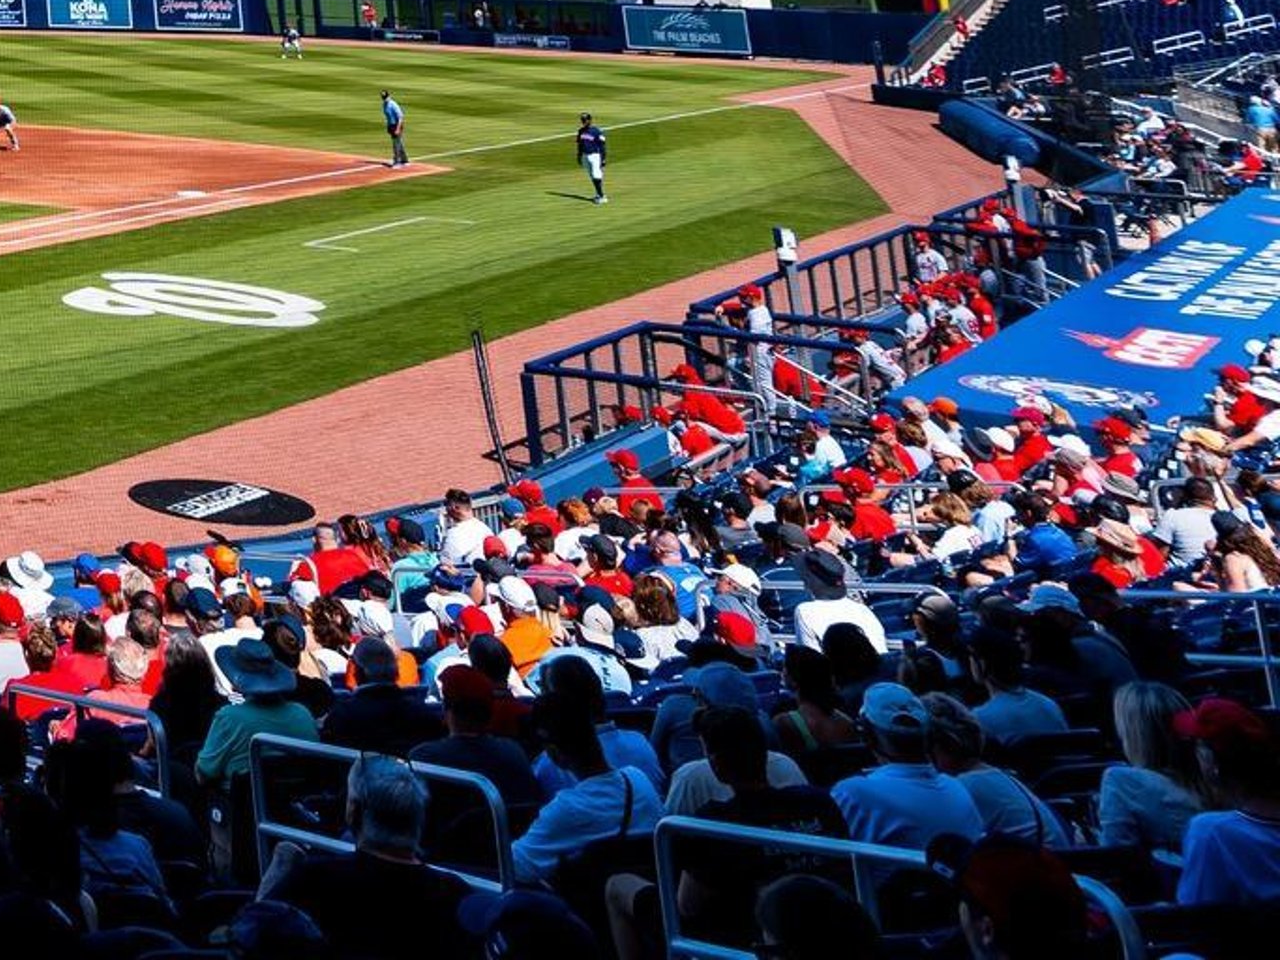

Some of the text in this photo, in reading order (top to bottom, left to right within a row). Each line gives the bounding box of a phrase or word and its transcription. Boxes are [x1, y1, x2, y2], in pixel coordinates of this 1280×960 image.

[70, 1, 107, 14] KONA
[653, 31, 721, 44] THE PALM BEACHES
